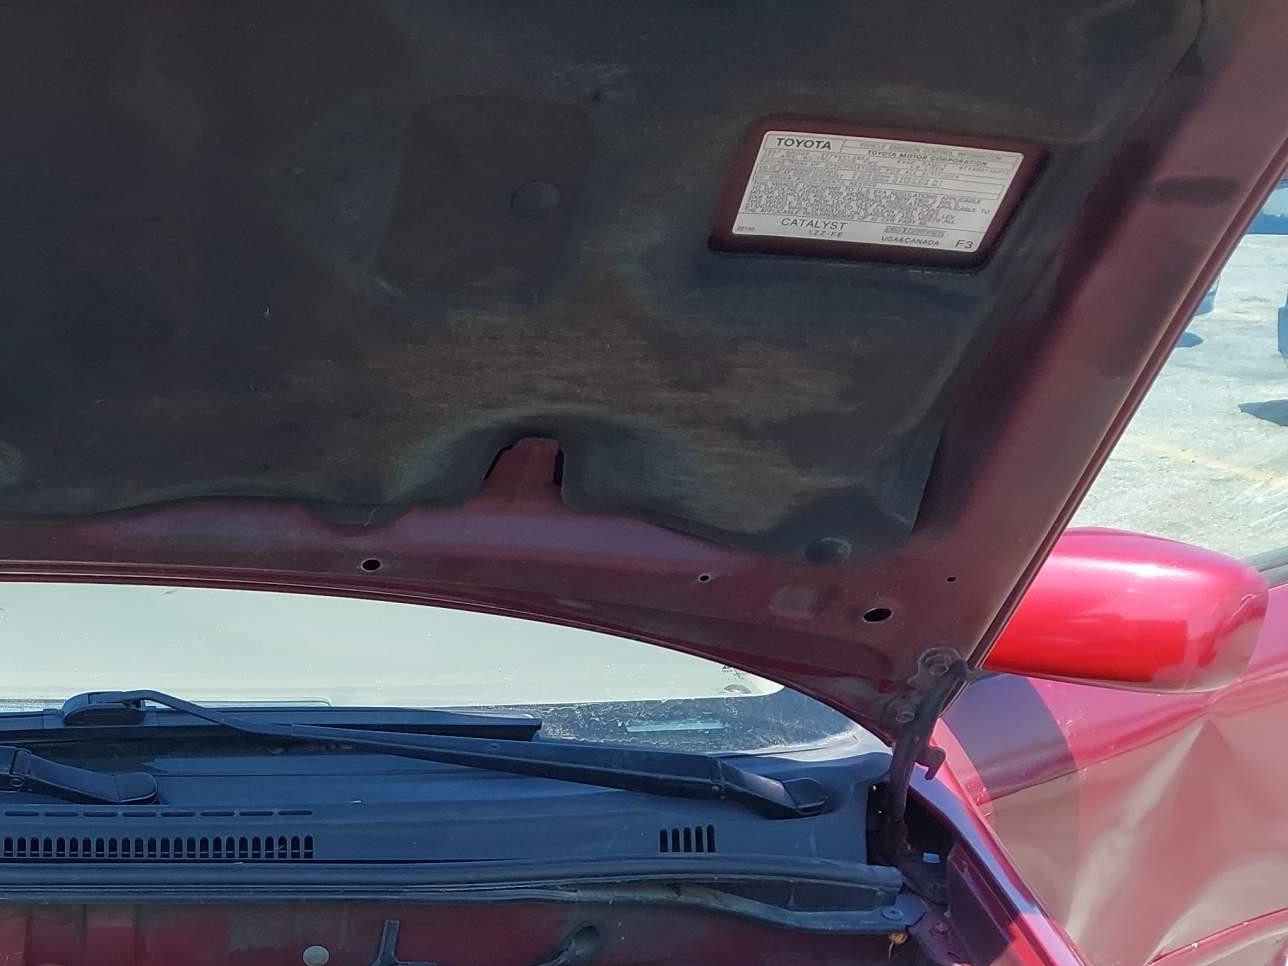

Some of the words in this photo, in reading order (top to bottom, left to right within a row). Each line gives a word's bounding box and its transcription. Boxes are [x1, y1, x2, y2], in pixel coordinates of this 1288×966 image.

[776, 137, 832, 150] TOYOTA
[781, 217, 848, 231] CATALYST
[881, 235, 940, 247] USA&CANADA
[955, 239, 974, 249] F3
